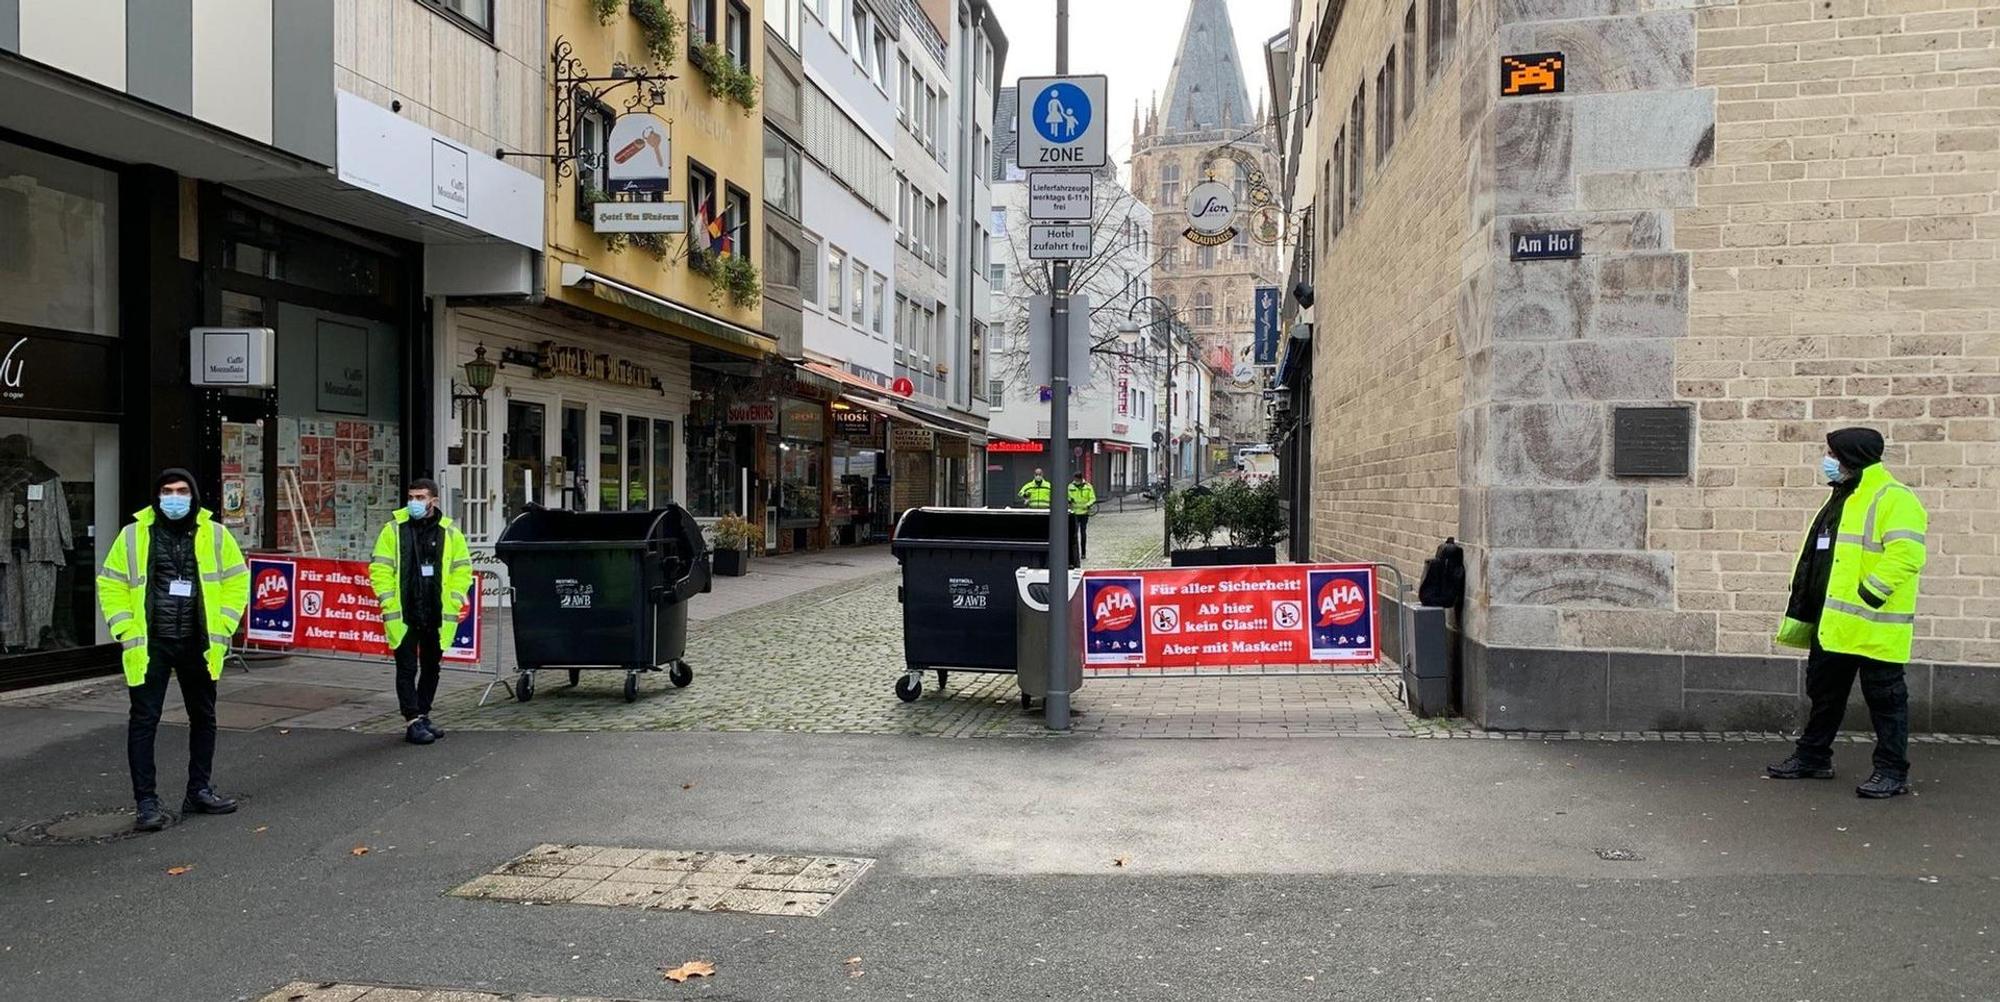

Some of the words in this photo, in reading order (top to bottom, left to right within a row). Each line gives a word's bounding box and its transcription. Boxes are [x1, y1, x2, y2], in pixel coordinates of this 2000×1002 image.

[1040, 147, 1084, 162] ZONE
[1033, 184, 1089, 193] Lieferfahrzeuge
[1033, 193, 1066, 203] werktags
[1084, 193, 1089, 201] h
[1053, 203, 1066, 211] frei
[1192, 196, 1229, 218] Sion
[1047, 229, 1074, 239] Hotel
[1187, 230, 1233, 246] BRAUHAUS
[1033, 242, 1068, 252] zufahrt
[1071, 242, 1089, 251] frei
[1517, 235, 1541, 252] Am
[1549, 233, 1575, 250] Hof
[837, 413, 869, 422] KIOSK
[300, 570, 323, 581] Für
[325, 572, 352, 585] aller
[256, 574, 289, 600] AHA
[1150, 583, 1177, 596] Für
[1180, 583, 1215, 595] aller
[1218, 579, 1301, 593] Sicherheit!
[338, 593, 355, 605] Ab
[357, 594, 379, 607] hier
[571, 594, 591, 606] AWB
[965, 595, 987, 607] AWB
[1095, 592, 1136, 620] AHA
[1320, 585, 1364, 615] AHA
[325, 608, 353, 620] kein
[1198, 603, 1219, 615] Ab
[1222, 602, 1254, 614] hier
[1185, 620, 1219, 633] kein
[1221, 618, 1268, 631] Glas!!!
[306, 626, 336, 638] Aber
[338, 628, 360, 641] mit
[1162, 643, 1199, 656] Aber
[1202, 641, 1229, 654] mit
[1231, 640, 1293, 653] Maske!!!
